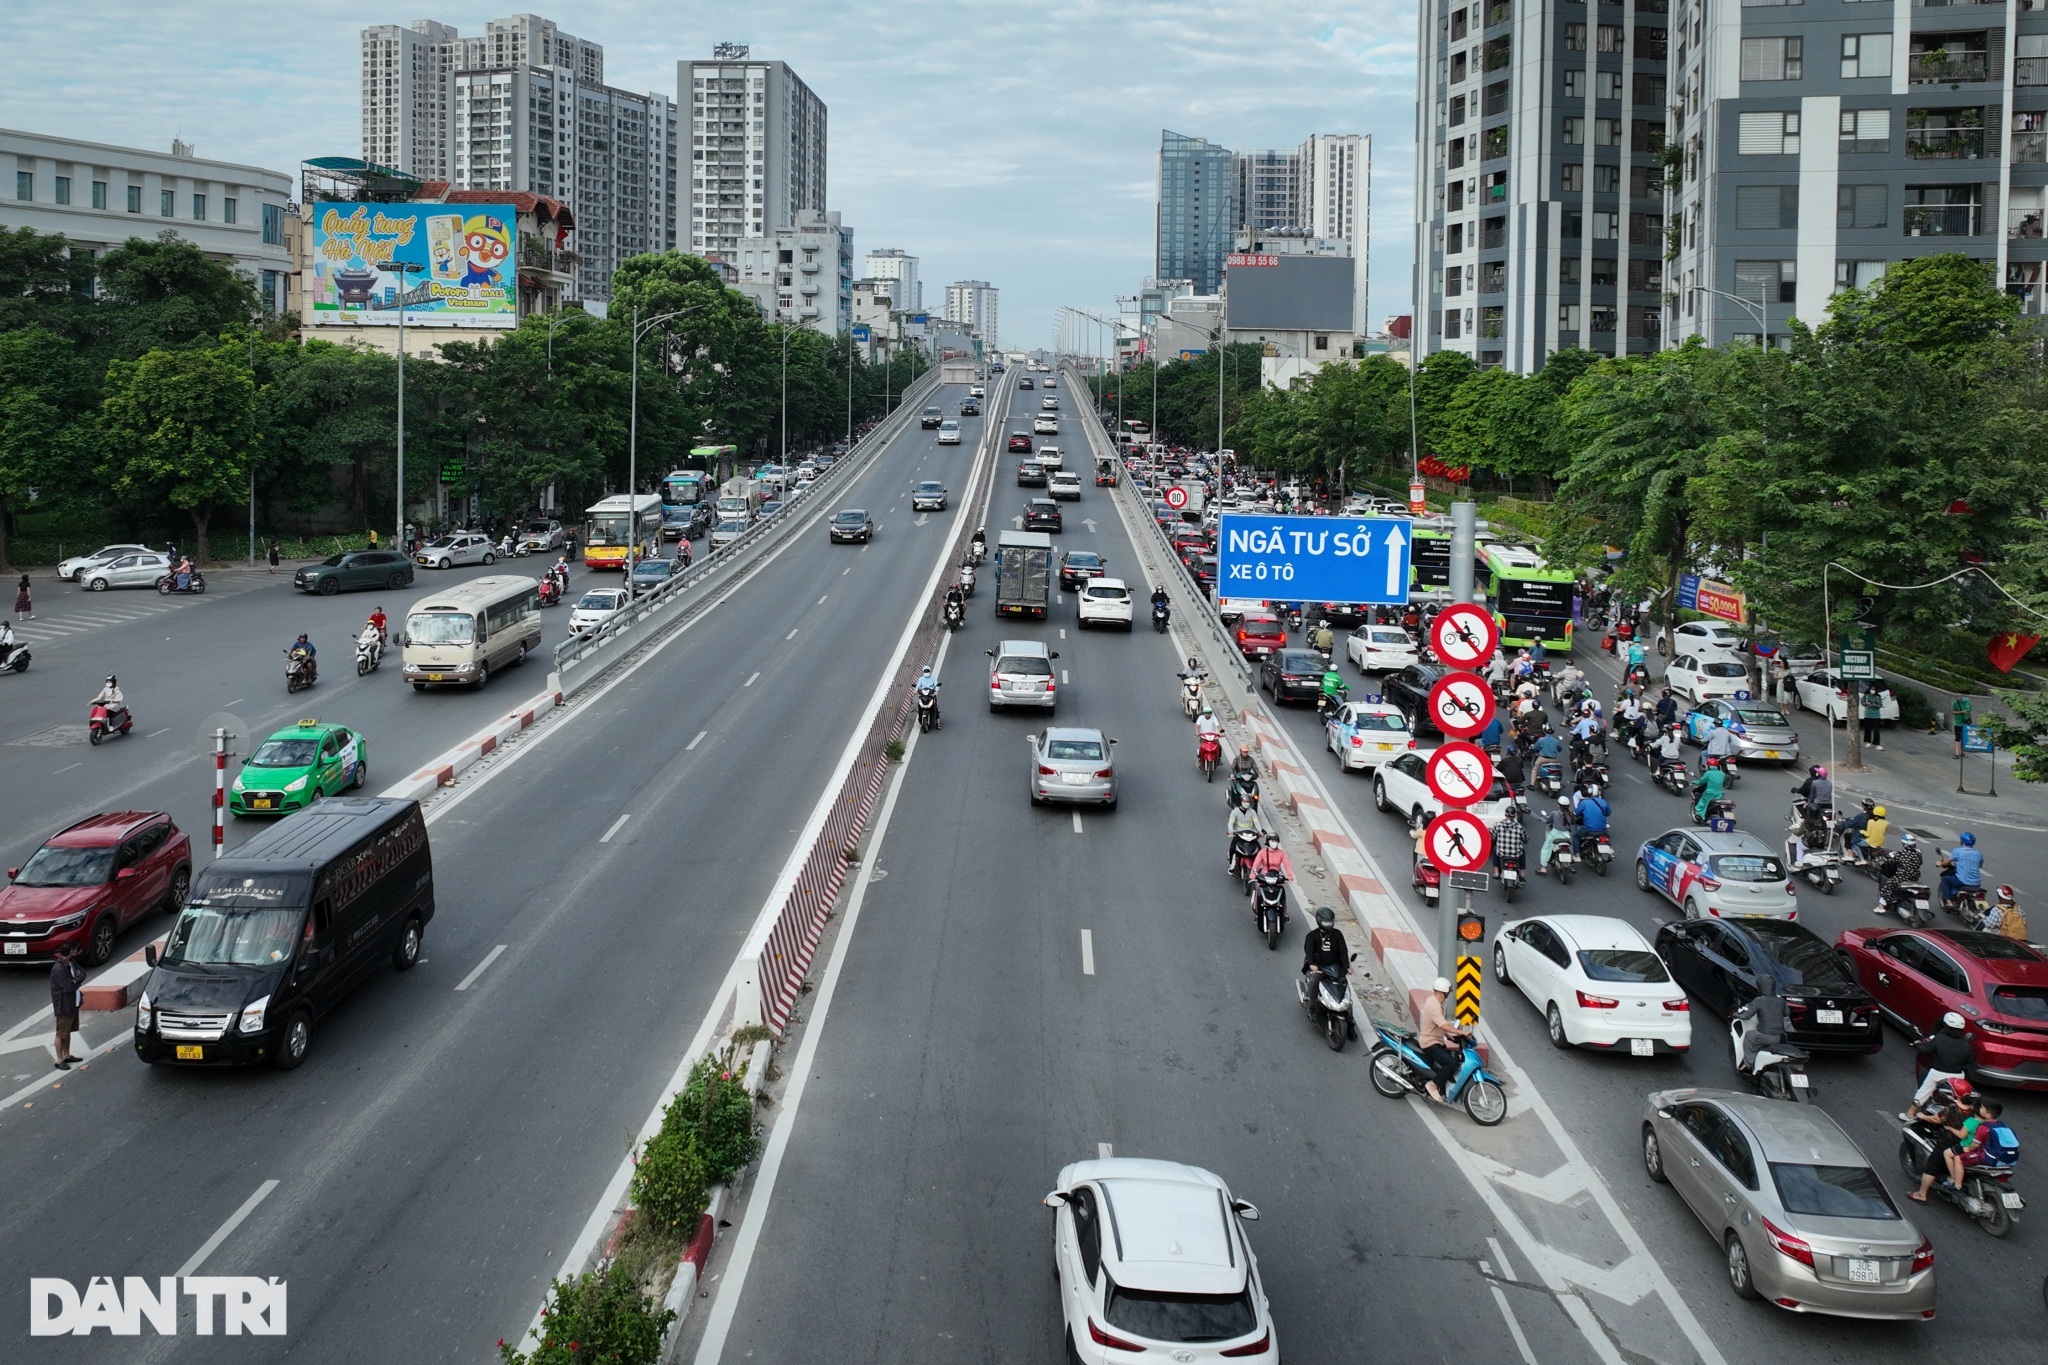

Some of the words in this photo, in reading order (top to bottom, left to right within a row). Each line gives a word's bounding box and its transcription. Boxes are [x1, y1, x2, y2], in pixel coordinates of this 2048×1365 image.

[323, 206, 371, 243] Quẩy
[373, 213, 416, 245] tung
[322, 239, 352, 261] Hà
[1227, 255, 1245, 265] 0988
[1247, 256, 1256, 265] 59
[1258, 256, 1267, 265] 55
[1269, 256, 1278, 265] 66
[430, 282, 469, 297] Pororo
[481, 289, 505, 298] MALL
[447, 298, 488, 308] Vietnam
[1229, 525, 1286, 555] NGÃ
[1289, 530, 1329, 556] TƯ
[1333, 524, 1372, 557] SỞ
[1229, 564, 1252, 579] XE
[1255, 562, 1268, 580] Ô
[1271, 562, 1295, 581] TÔ
[1844, 655, 1868, 664] VICTORY
[1842, 665, 1870, 674] BILLIARDS
[1717, 820, 1729, 831] G7
[209, 887, 284, 896] LIMOUSINE
[1856, 1260, 1873, 1271] 30E
[1849, 1271, 1879, 1282] 298.04
